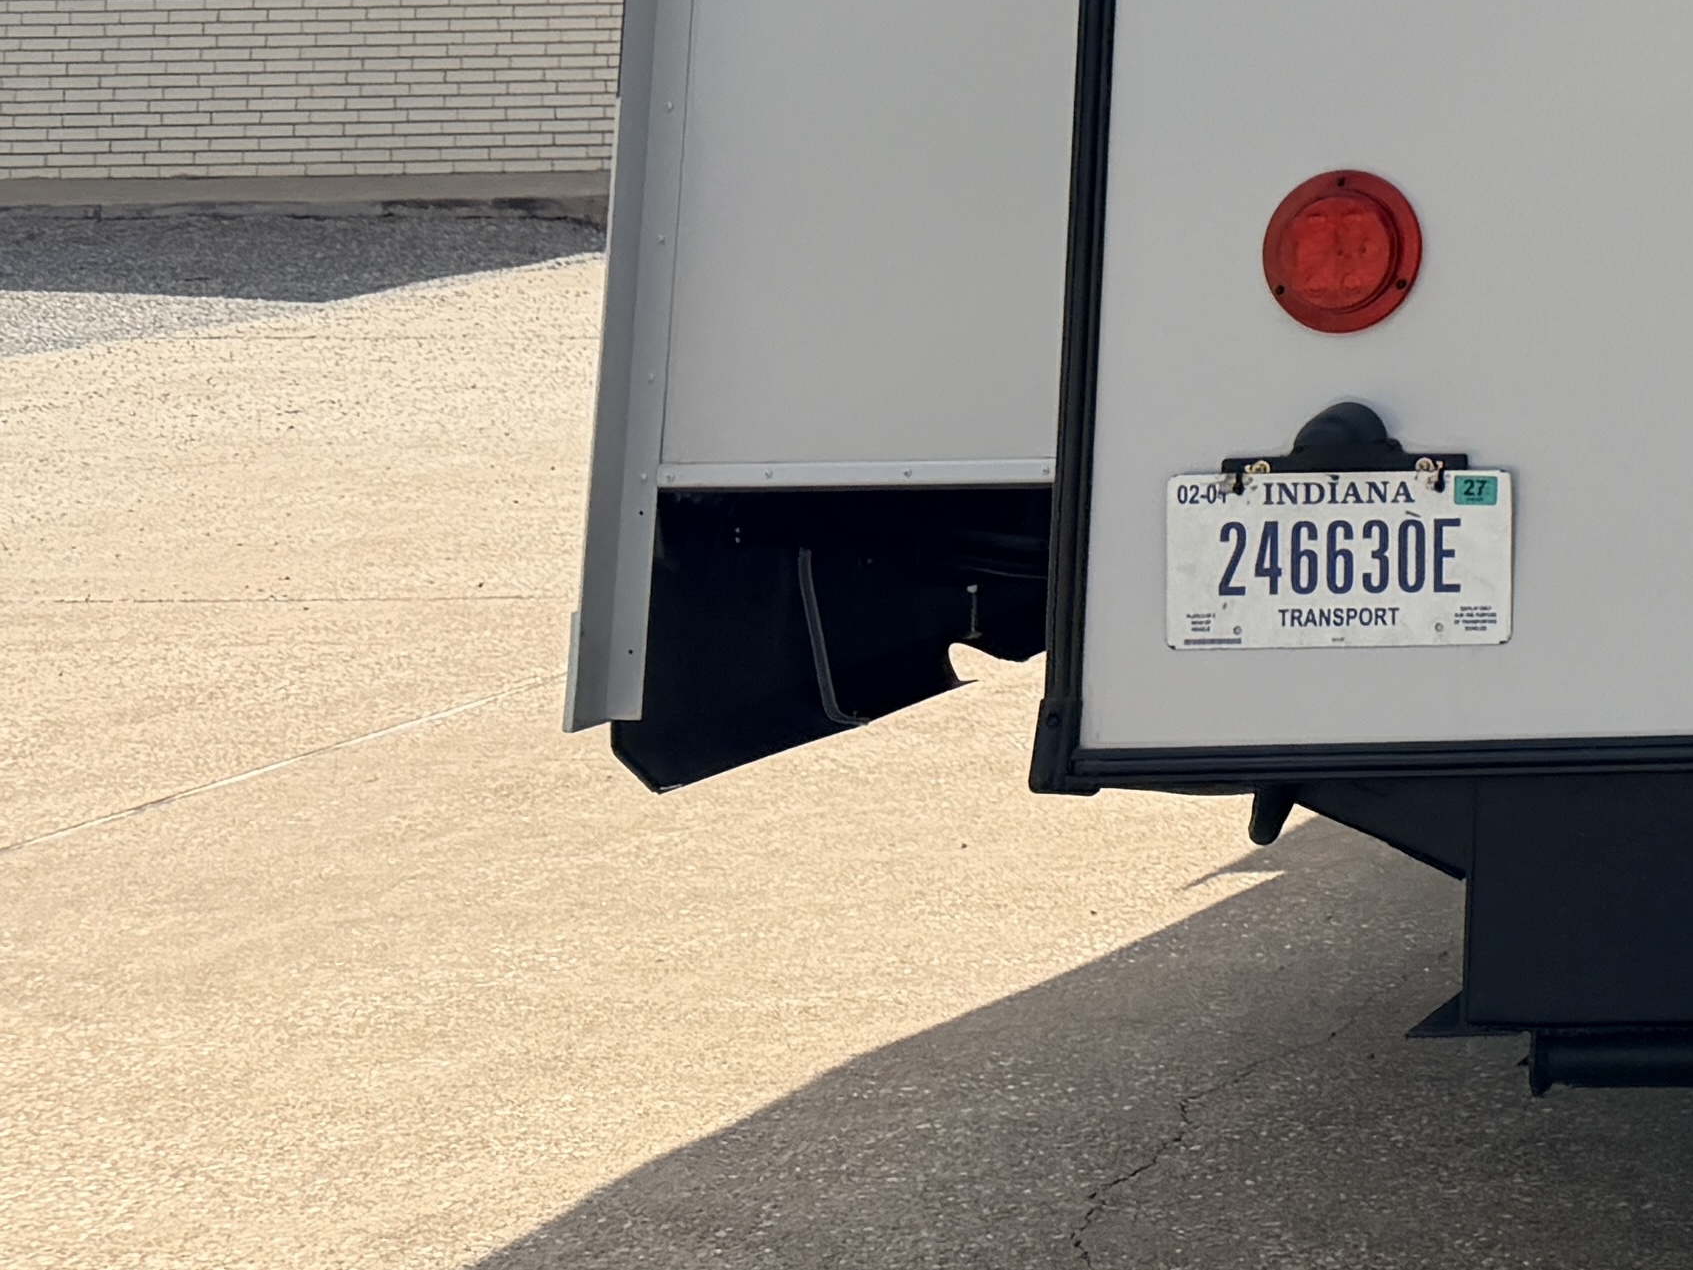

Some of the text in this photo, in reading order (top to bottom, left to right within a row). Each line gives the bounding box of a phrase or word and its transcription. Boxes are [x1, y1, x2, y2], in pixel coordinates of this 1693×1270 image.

[1263, 481, 1417, 506] INDIANA
[1463, 478, 1487, 497] 27
[1218, 517, 1462, 597] 246630E
[1278, 607, 1400, 628] TRANSPORT
